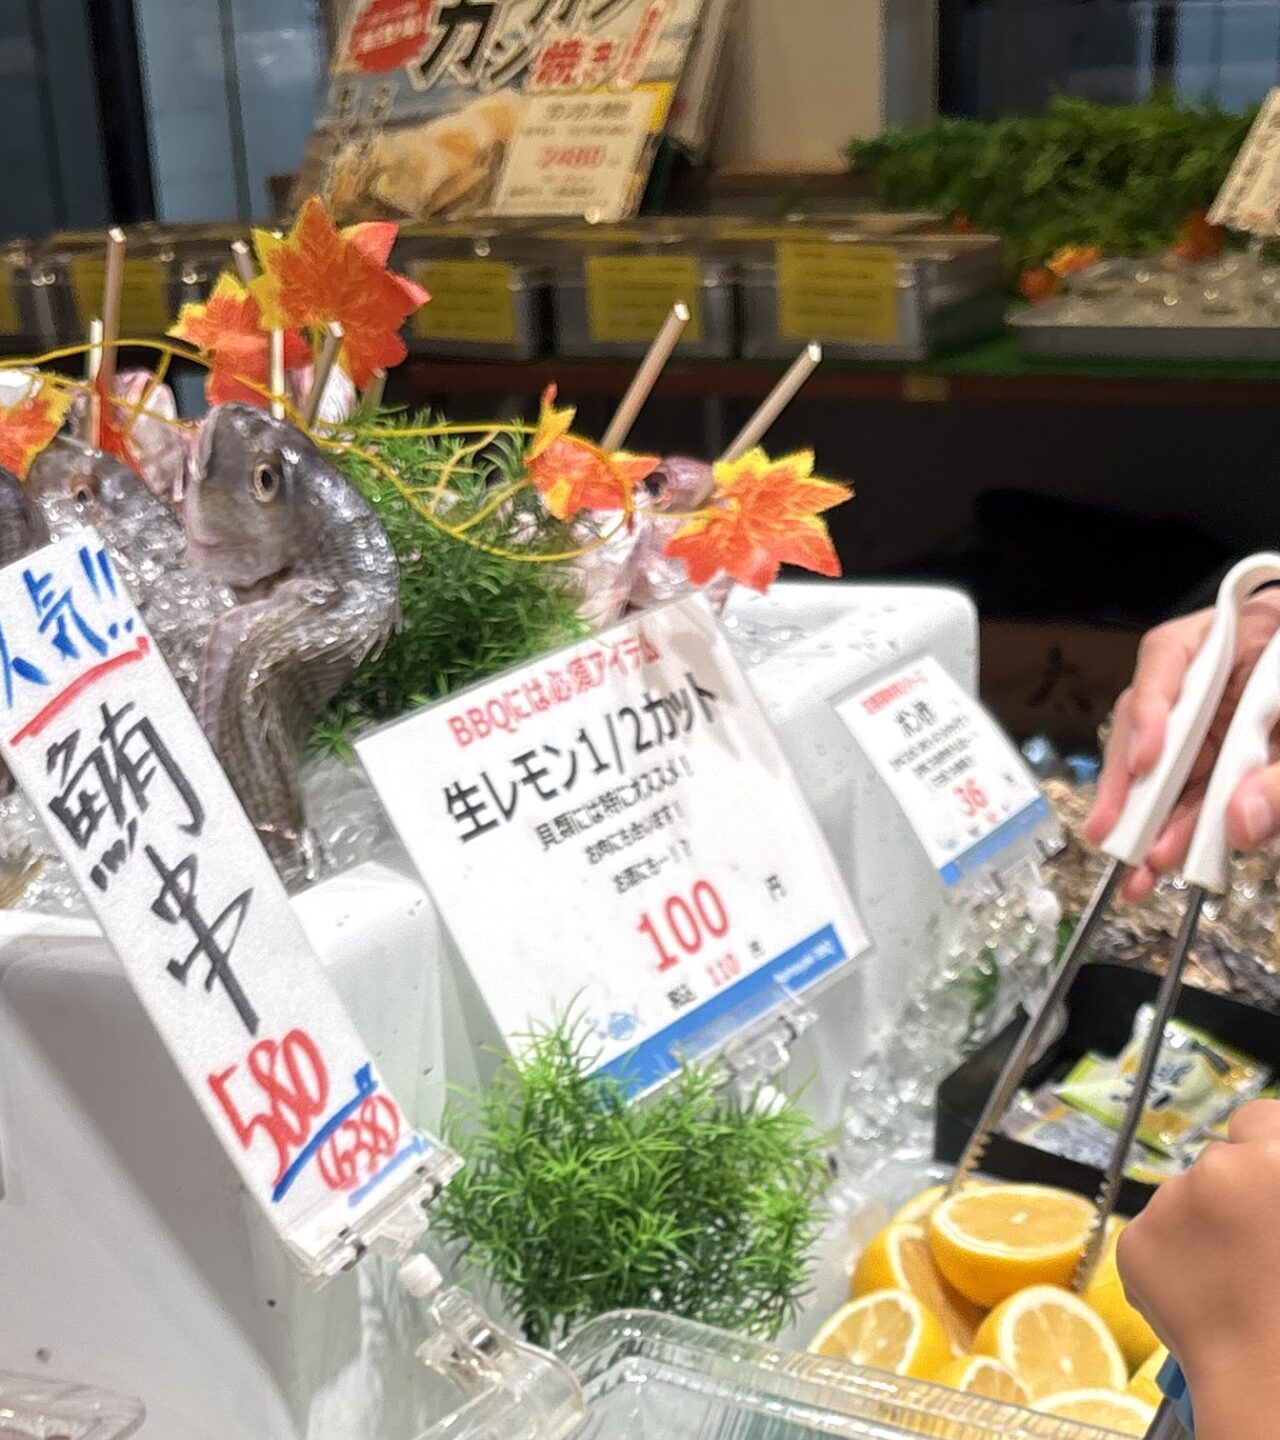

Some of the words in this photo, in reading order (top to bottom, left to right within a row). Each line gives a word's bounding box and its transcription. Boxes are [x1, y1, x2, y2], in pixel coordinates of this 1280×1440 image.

[443, 672, 718, 843] 生レモン1/2カット
[447, 634, 661, 748] BBQには必須アイテム
[638, 880, 730, 972] 100
[207, 1029, 330, 1188] 580
